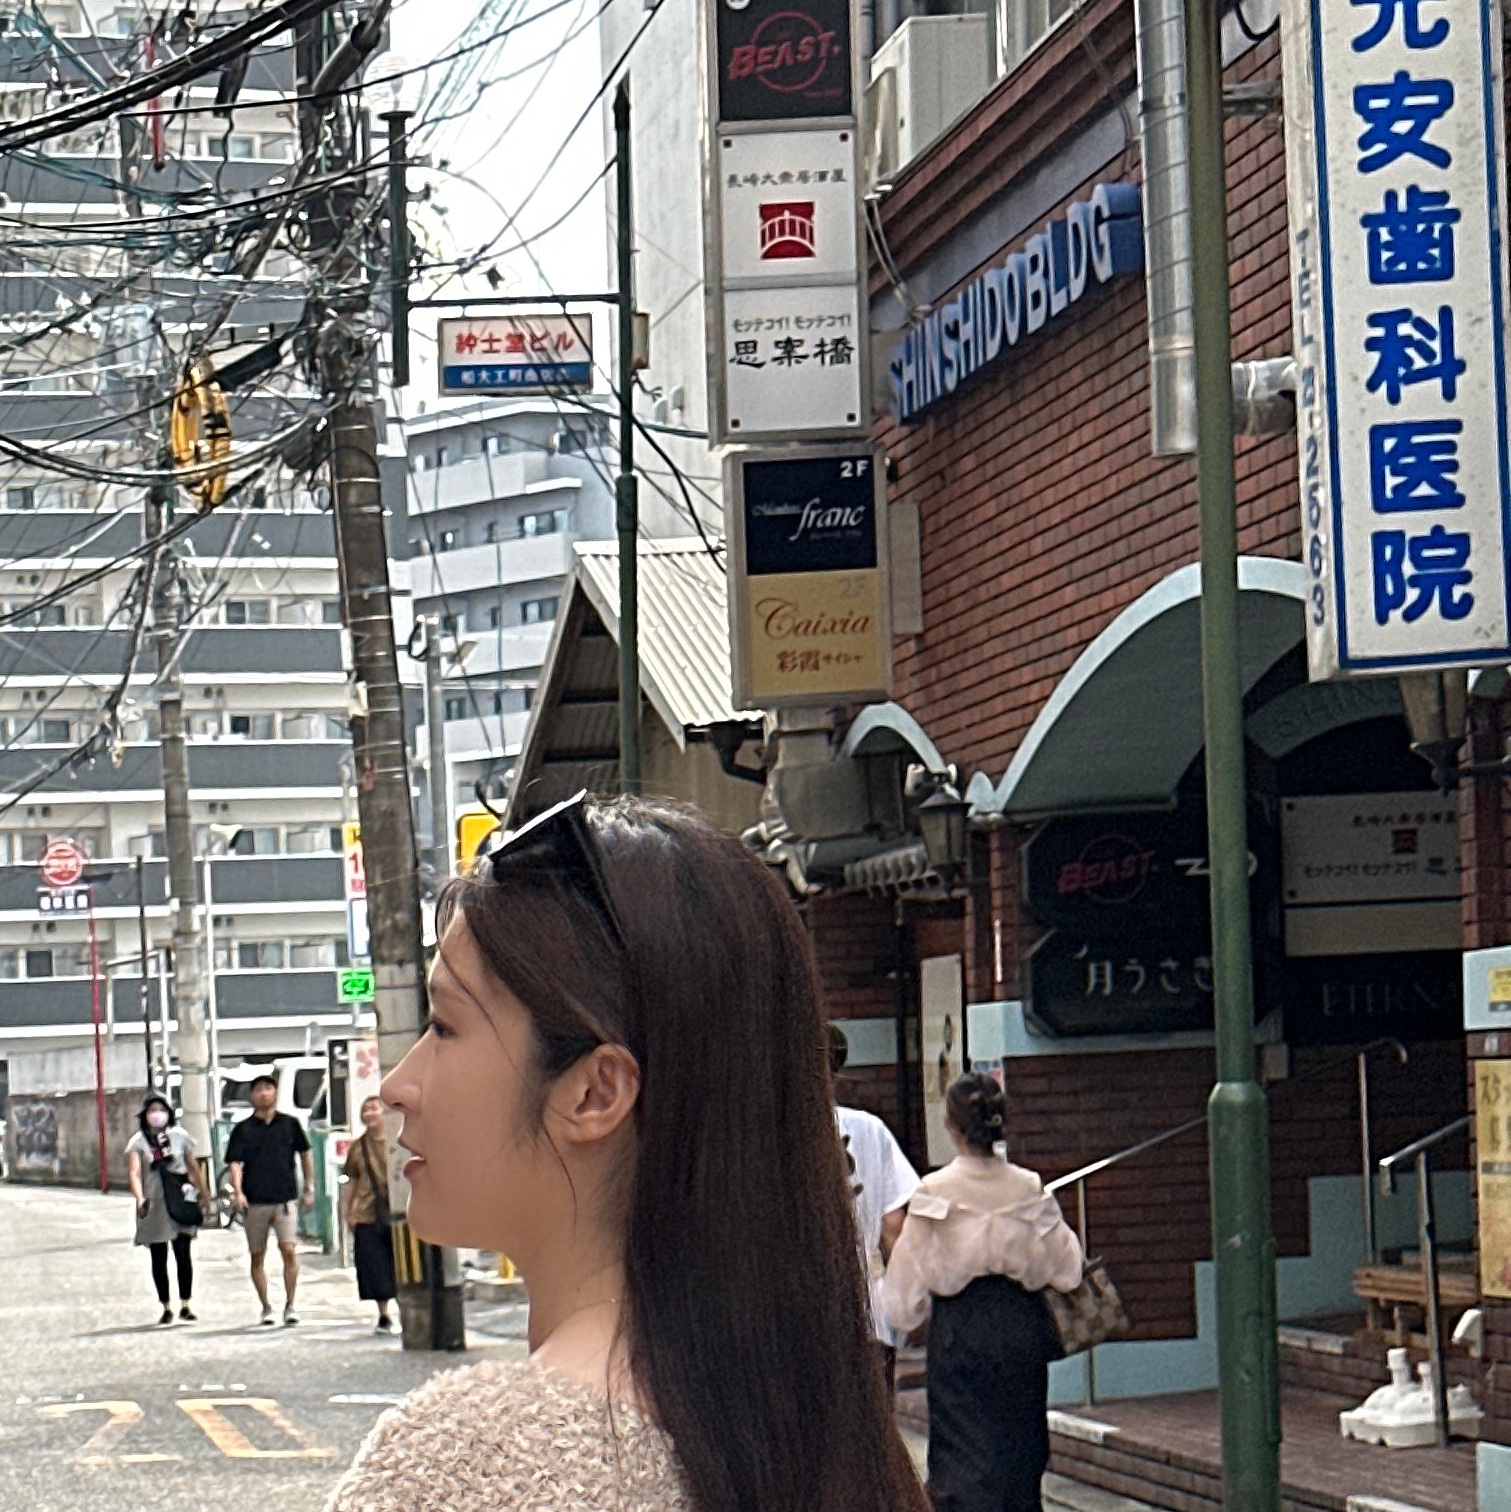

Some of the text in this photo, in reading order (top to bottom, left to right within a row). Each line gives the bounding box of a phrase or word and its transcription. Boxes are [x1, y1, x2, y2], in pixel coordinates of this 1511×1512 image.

[728, 336, 855, 370] 思案橋
[841, 459, 870, 479] 2F
[789, 497, 866, 542] franc
